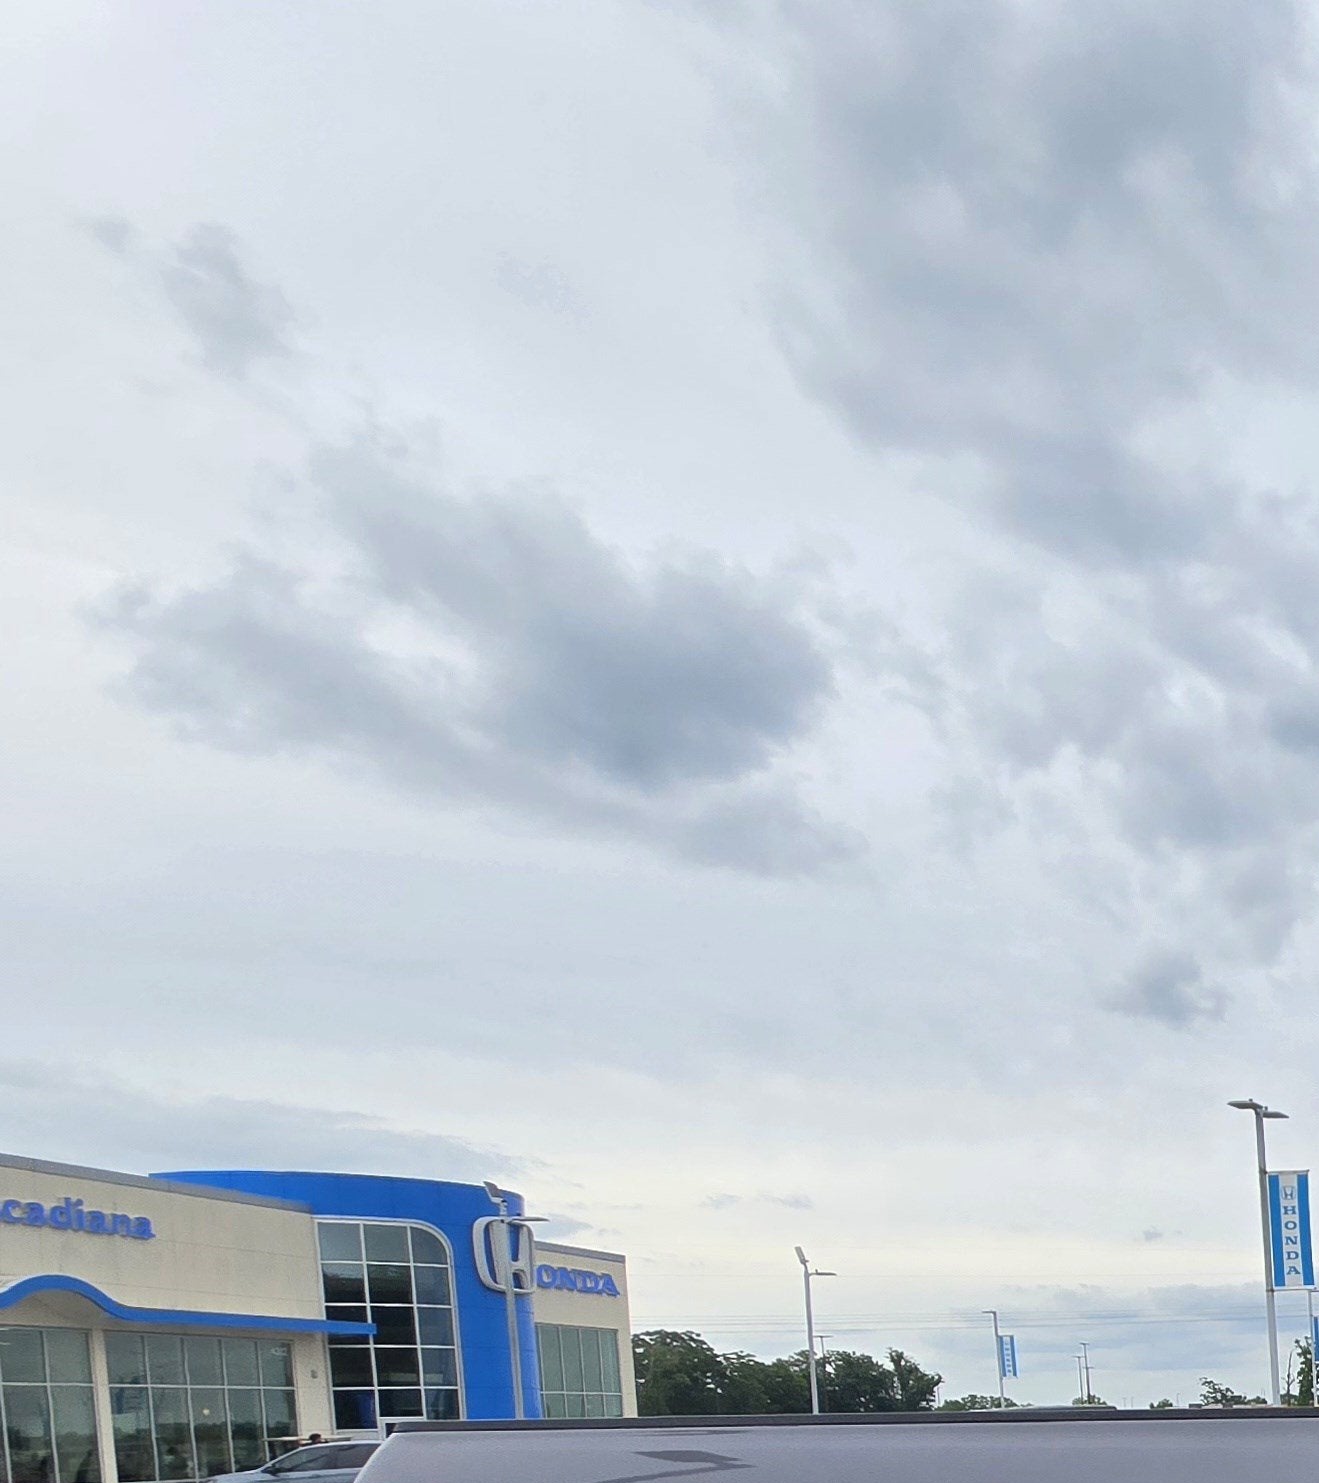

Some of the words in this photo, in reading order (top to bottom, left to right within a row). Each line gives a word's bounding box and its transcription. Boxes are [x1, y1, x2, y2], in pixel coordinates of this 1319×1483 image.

[0, 1197, 156, 1241] cadiana
[1282, 1205, 1301, 1276] HONDA
[536, 1263, 621, 1298] ONDA
